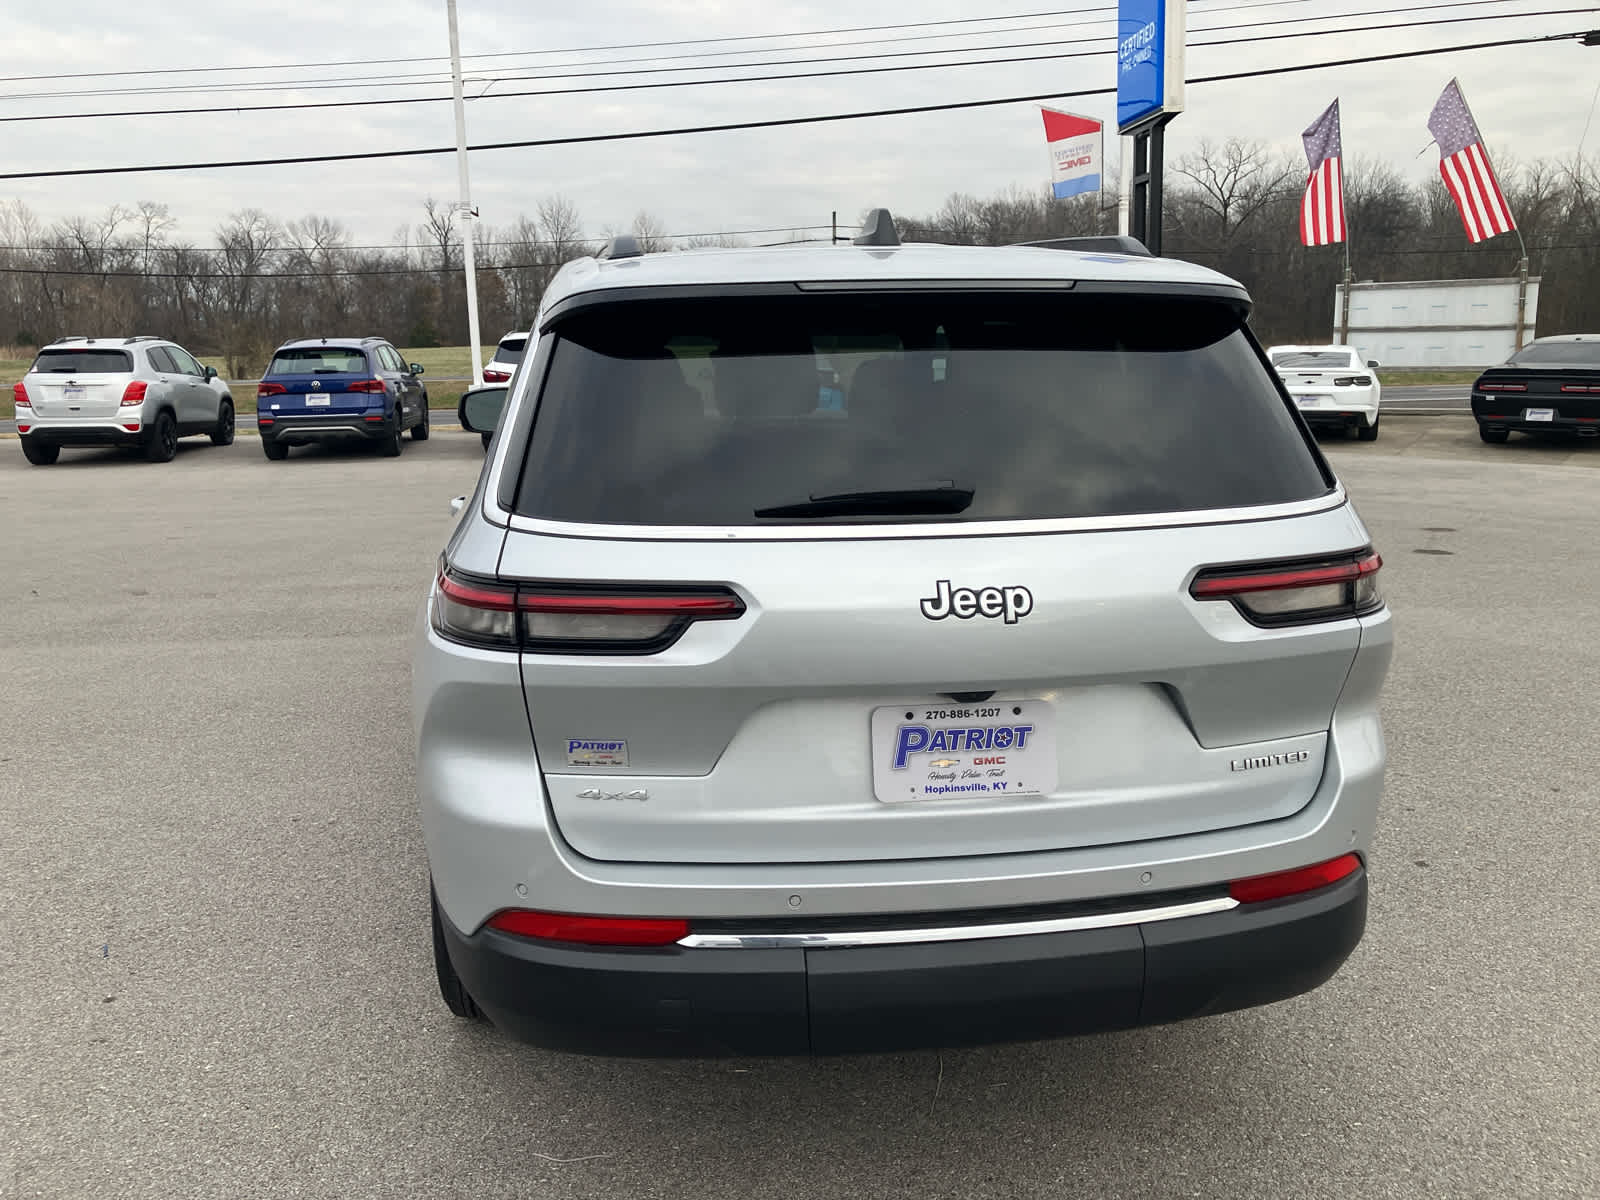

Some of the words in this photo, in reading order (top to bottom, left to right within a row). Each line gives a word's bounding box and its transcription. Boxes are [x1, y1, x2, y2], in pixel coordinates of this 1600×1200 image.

[1119, 21, 1155, 59] CERTIFIED
[920, 579, 1033, 625] Jeep
[925, 708, 1001, 720] 270-886-1207
[568, 740, 624, 753] PATRIOT
[892, 724, 1034, 769] PATRIOT
[973, 756, 1006, 766] GMC
[1230, 750, 1310, 772] LIMITED
[925, 783, 990, 795] Hopkinsville,
[993, 781, 1008, 790] KY
